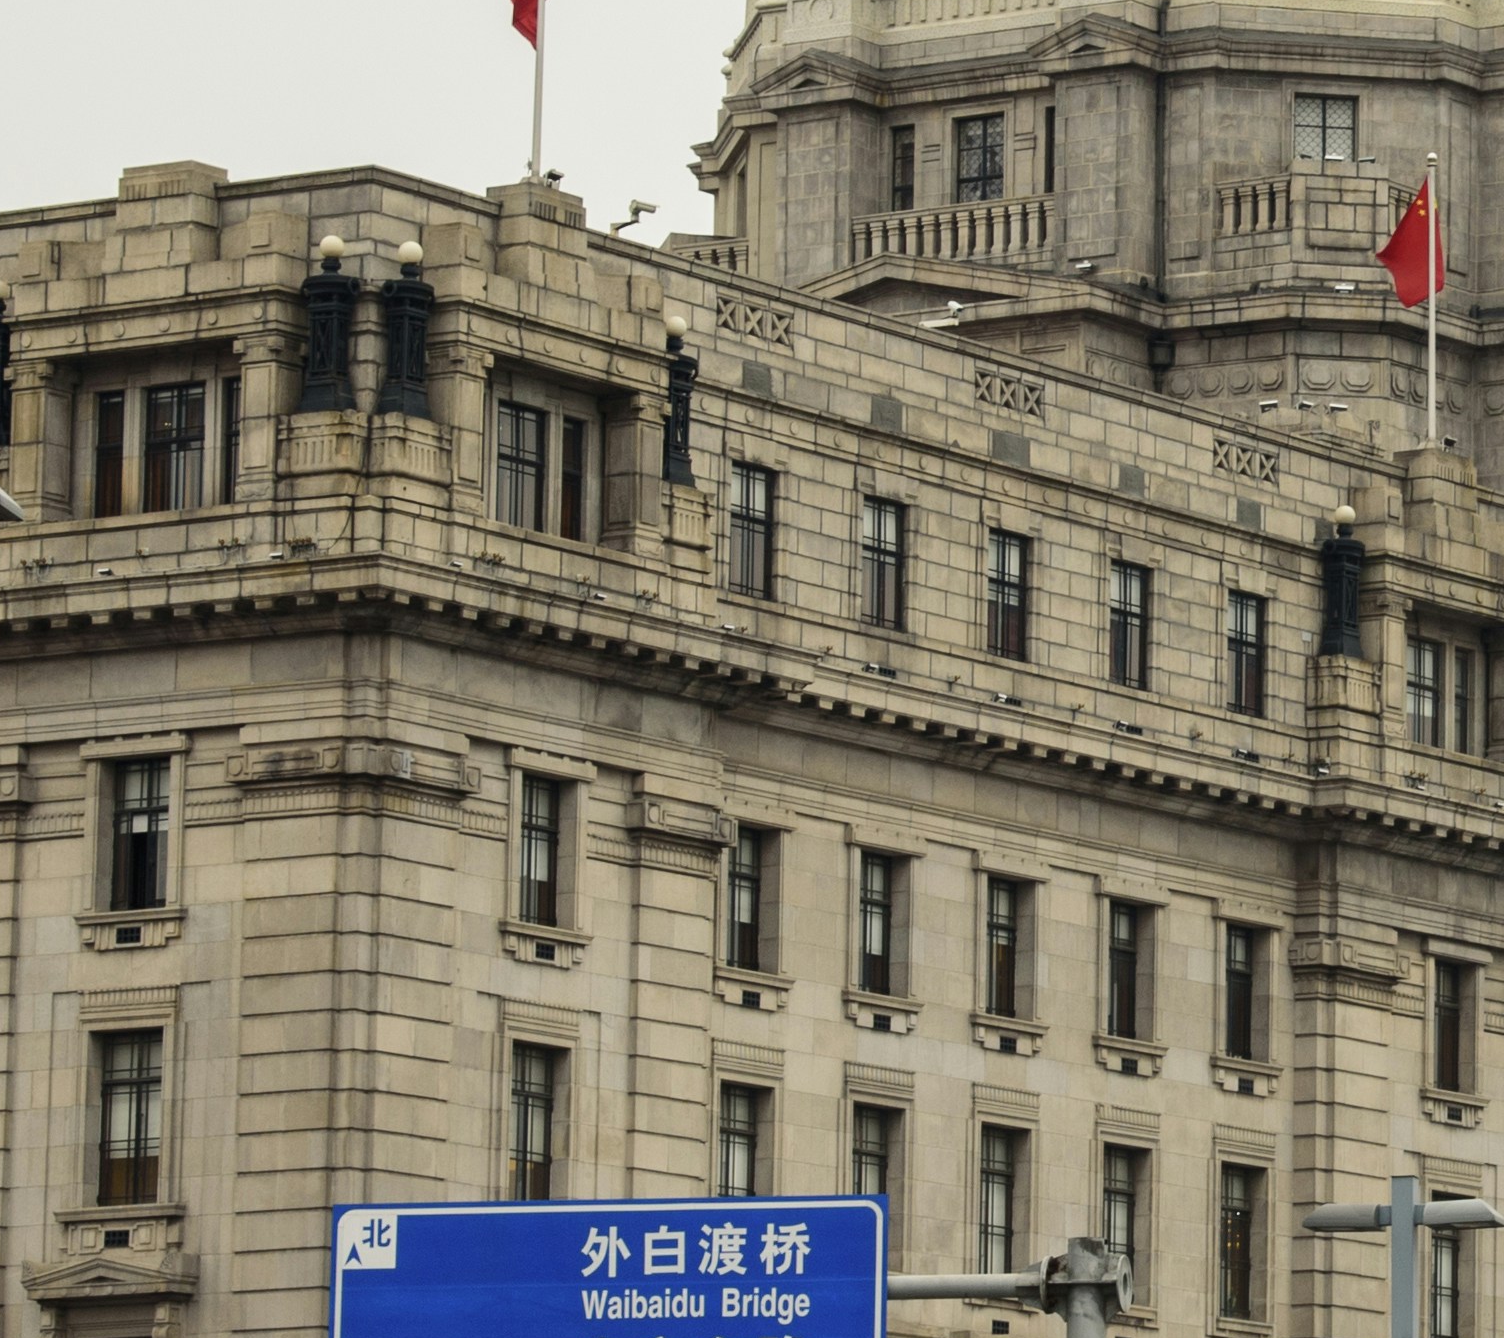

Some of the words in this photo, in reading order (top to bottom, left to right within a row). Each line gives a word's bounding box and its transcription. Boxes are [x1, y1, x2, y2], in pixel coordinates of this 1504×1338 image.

[362, 1218, 391, 1248] 北
[581, 1222, 811, 1277] 外白渡桥
[582, 1288, 705, 1320] Waibaidu
[721, 1287, 810, 1324] Bridge
